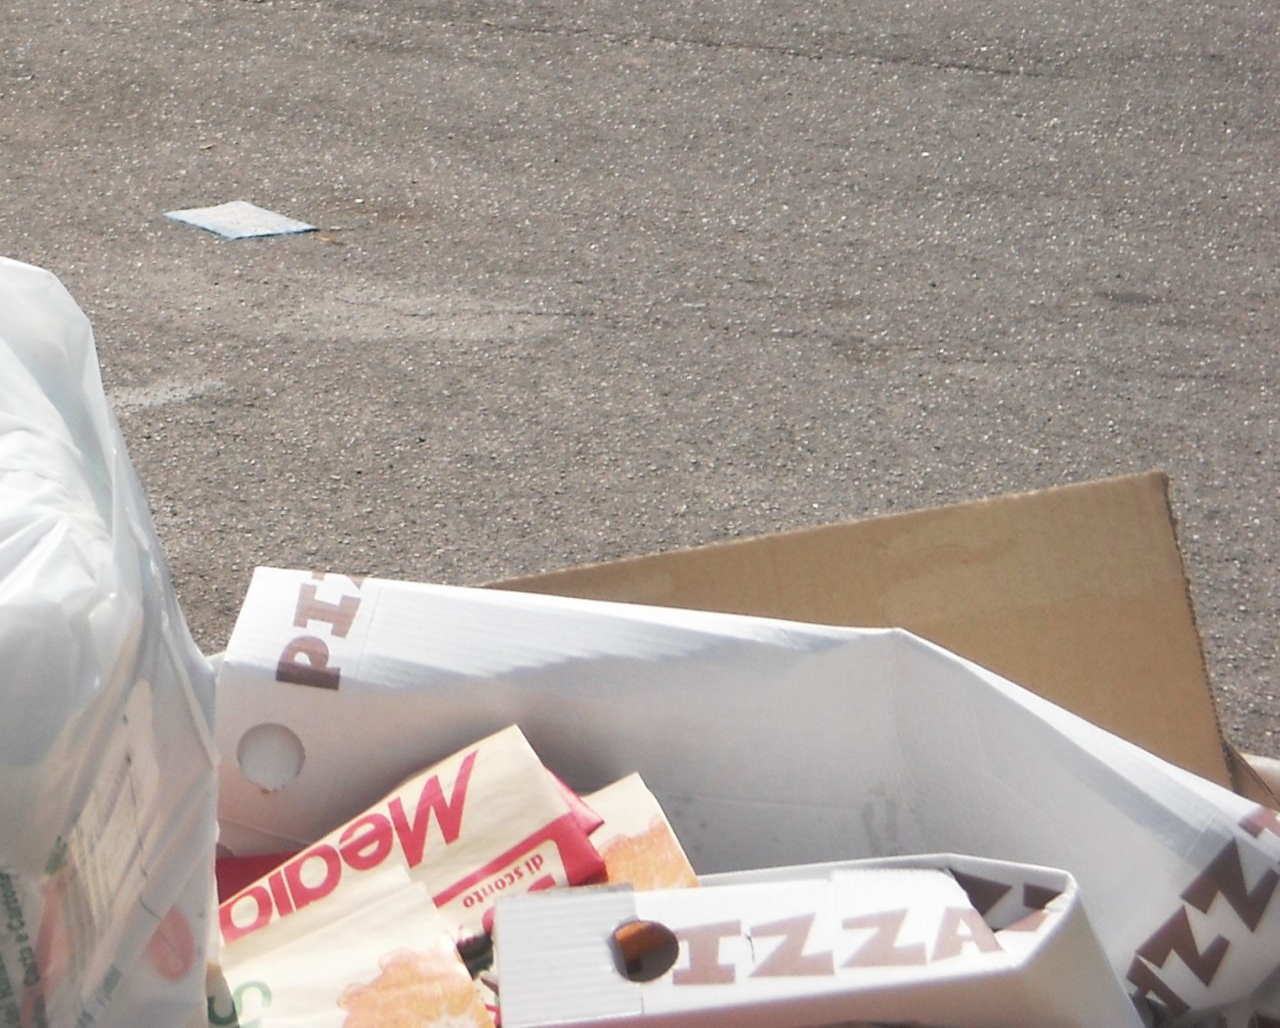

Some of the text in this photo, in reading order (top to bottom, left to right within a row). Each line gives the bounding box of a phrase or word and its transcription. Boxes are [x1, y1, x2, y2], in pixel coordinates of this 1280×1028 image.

[524, 853, 544, 875] di
[462, 865, 524, 908] sconto
[672, 906, 1007, 986] IZZA
